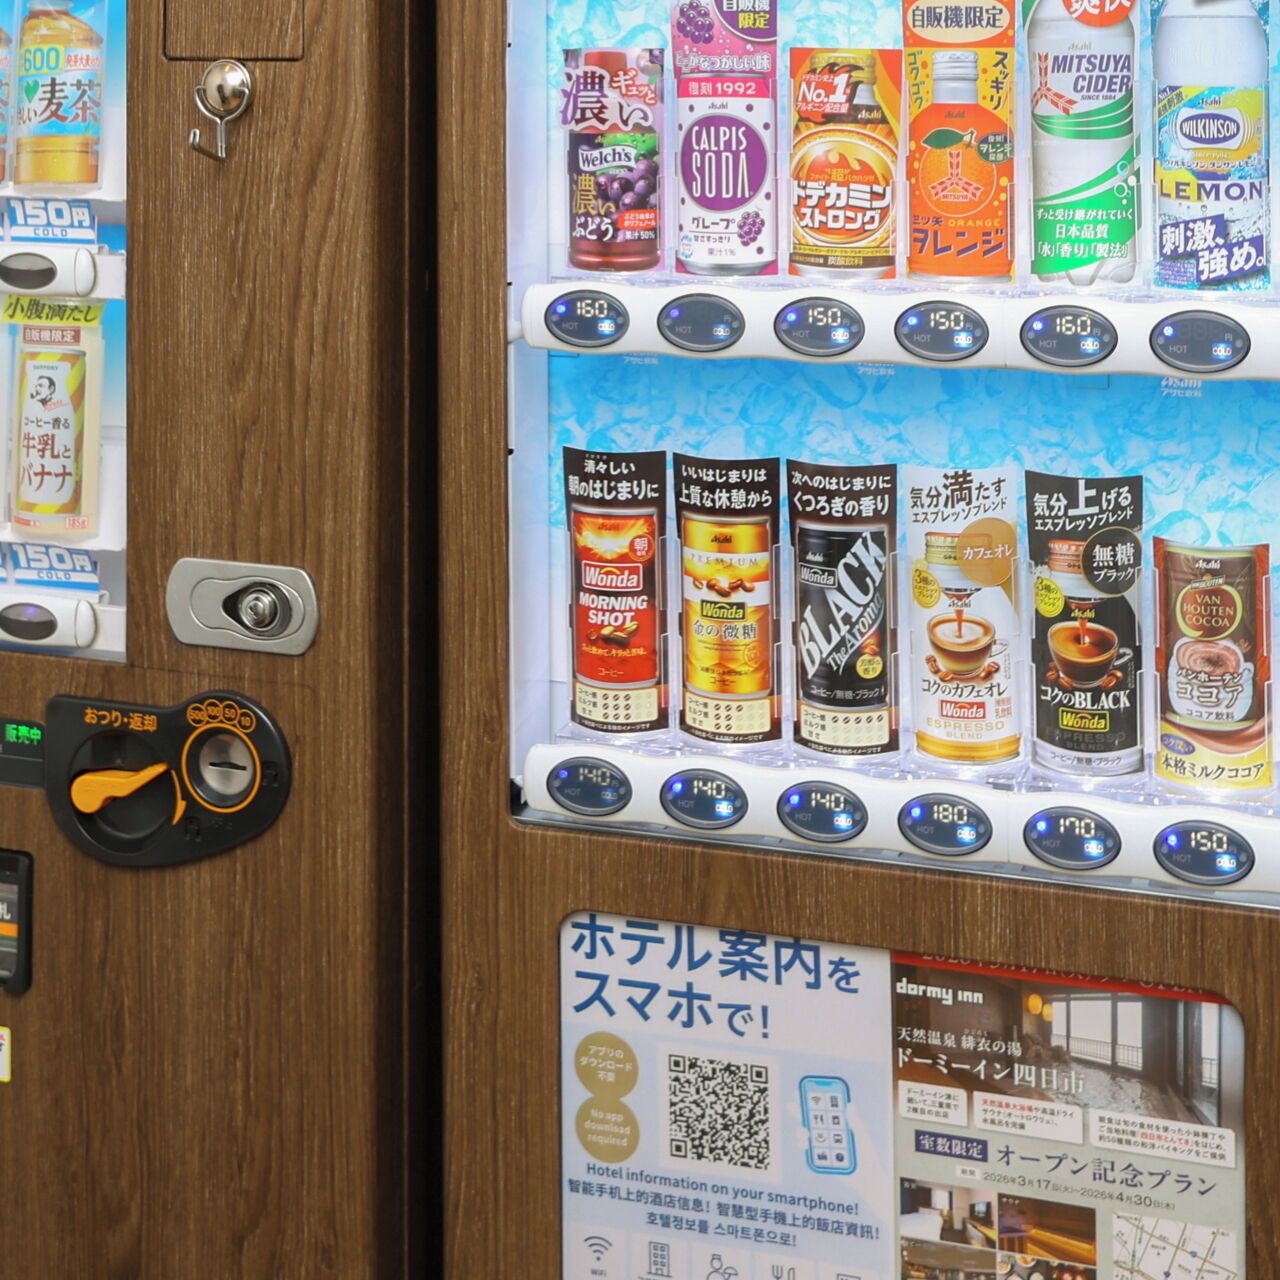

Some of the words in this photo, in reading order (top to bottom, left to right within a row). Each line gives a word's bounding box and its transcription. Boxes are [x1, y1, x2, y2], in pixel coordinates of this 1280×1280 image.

[738, 12, 771, 29] 限定
[912, 5, 1004, 29] 自販機限定
[1051, 54, 1133, 74] MITSUYA
[716, 82, 756, 95] 1992
[798, 72, 852, 104] No.1
[907, 50, 926, 111] ゴクゴク
[990, 50, 1010, 111] スッキリ
[1072, 74, 1134, 95] CIDER
[691, 126, 748, 151] CALPIS
[1181, 118, 1238, 140] WILKINSON
[580, 145, 633, 167] Welch's
[692, 152, 751, 199] SODA
[793, 180, 892, 209] ドデカミン
[1160, 180, 1263, 202] LEMON
[10, 200, 92, 228] 150円
[692, 218, 736, 231] グレープ
[800, 207, 882, 231] ストロング
[913, 214, 944, 226] 三ツ矢
[948, 218, 1002, 228] ORANGE
[1036, 208, 1134, 220] ずっと受け継がれていく
[572, 216, 614, 241] ぶどう
[1055, 224, 1109, 239] 日本品質
[1198, 241, 1265, 281] 強め。
[4, 297, 99, 323] 小腹満たし
[22, 432, 72, 460] 牛乳と
[21, 464, 72, 493] バナナ
[682, 464, 768, 483] いいはじまりは
[792, 470, 893, 491] 次へのはじまりに
[568, 475, 659, 501] 朝のはじまりに
[679, 482, 773, 510] 上質な休憩から
[910, 470, 1006, 510] 気分満たす
[1033, 479, 1132, 518] 気分上げる
[793, 491, 890, 518] くつろぎの香り
[962, 544, 1013, 561] カフェオレ
[584, 566, 639, 588] Wonda
[579, 592, 649, 611] MORNING
[1183, 603, 1234, 616] HOUTEN
[1195, 593, 1221, 604] VAN
[588, 610, 635, 626] SHOT
[702, 603, 744, 619] Wonda
[1185, 615, 1231, 627] COCOA
[921, 678, 1009, 698] コクのカフェオレ
[4, 723, 42, 744] 販売中
[926, 717, 1006, 731] ESPRESSO
[1161, 754, 1265, 780] 本格ミルクココア
[570, 913, 861, 994] ホテル案内を
[895, 977, 954, 1006] dormy
[957, 990, 984, 1005] inn
[573, 969, 771, 1039] スマホで!
[897, 1025, 957, 1049] 天然温泉
[961, 1035, 1023, 1057] 緋衣の湯
[579, 1055, 633, 1073] ダウンロード
[897, 1047, 1086, 1095] ドーミーイン四日市
[591, 1108, 605, 1119] No
[584, 1119, 631, 1135] download
[587, 1133, 628, 1149] required
[917, 1133, 985, 1160] 室数限定
[997, 1144, 1217, 1197] オープン記念プラン
[568, 1178, 711, 1213] 智能手机上的酒店信息!
[586, 1162, 623, 1179] Hotel
[626, 1168, 709, 1193] information
[711, 1184, 728, 1195] on
[732, 1187, 764, 1203] your
[767, 1191, 860, 1216] smartphone!
[646, 1211, 709, 1235] 호텔정보를
